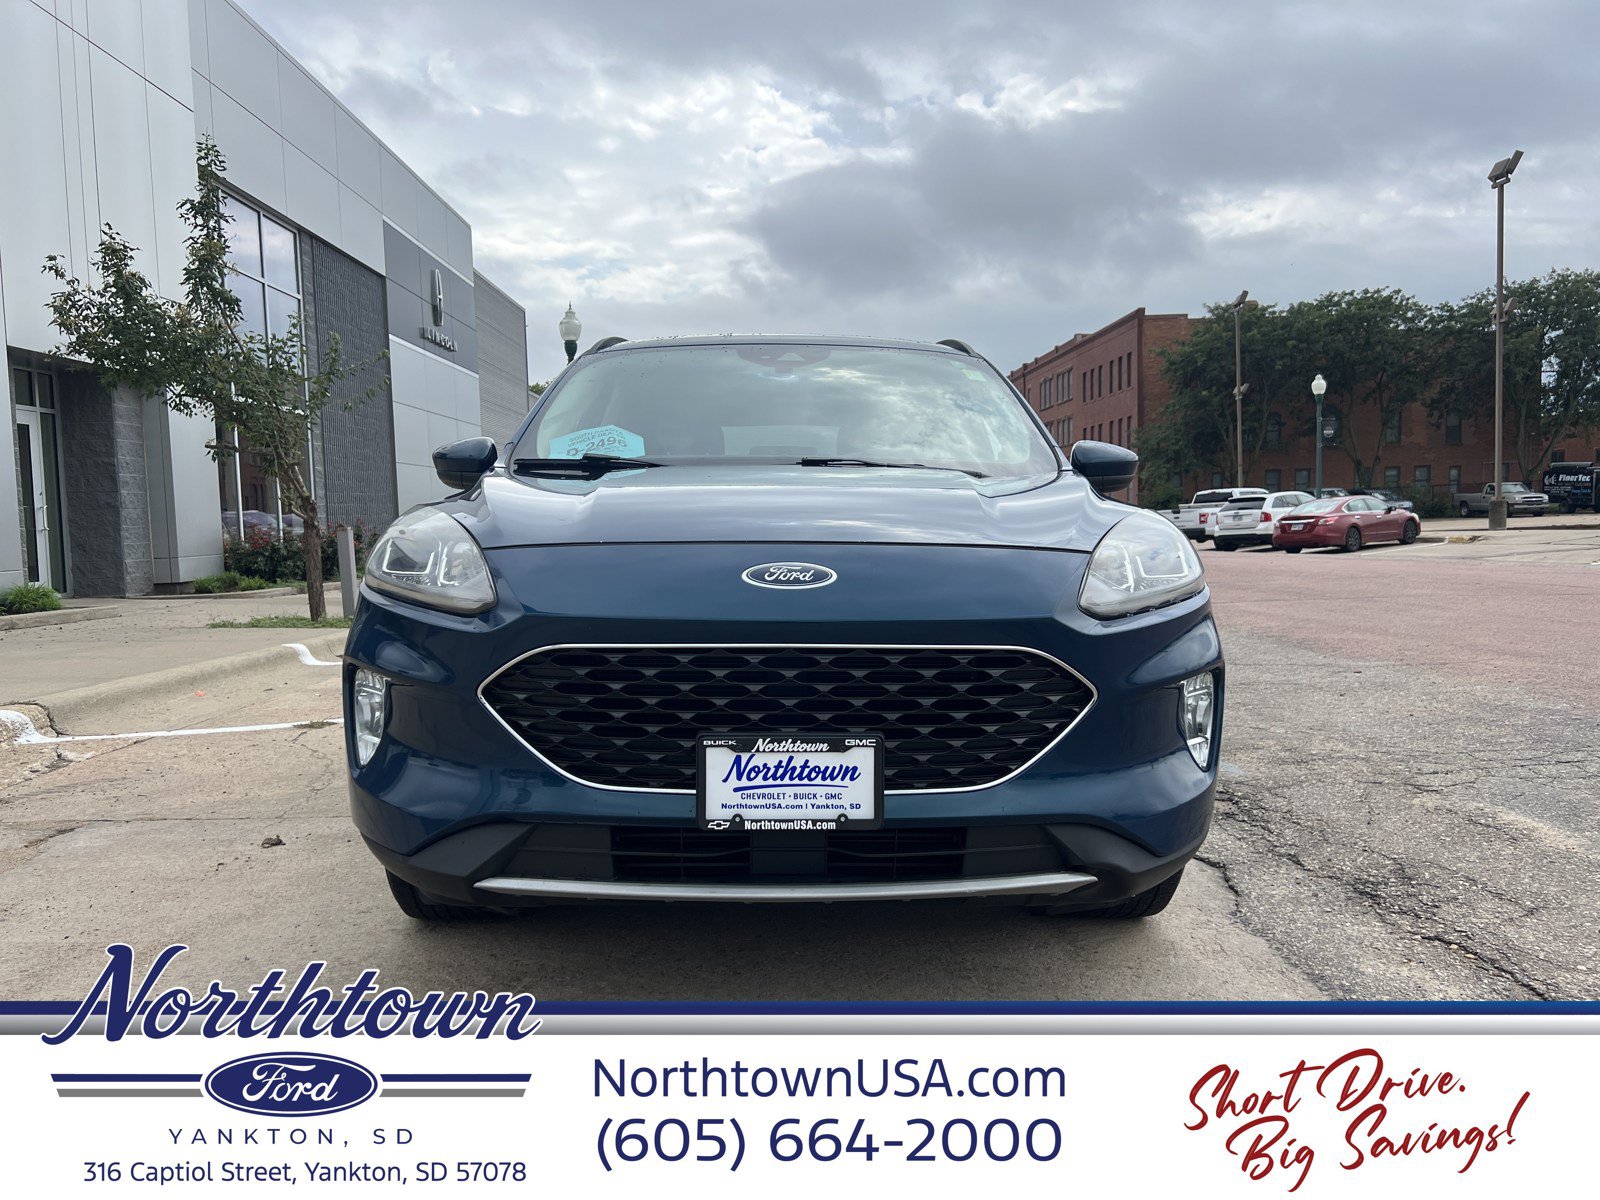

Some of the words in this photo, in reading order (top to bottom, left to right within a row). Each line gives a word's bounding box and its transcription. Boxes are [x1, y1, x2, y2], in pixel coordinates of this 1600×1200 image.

[764, 565, 815, 581] Ford
[751, 738, 830, 753] Northtown
[721, 753, 862, 783] Northtown
[740, 792, 787, 800] CHEVROLET
[793, 792, 818, 800] BUICK
[824, 792, 843, 800] GMC
[721, 802, 803, 810] NorthtownUSA.com
[810, 802, 848, 811] Yankton,
[849, 802, 862, 810] SD
[744, 820, 836, 830] NorthtownUSA.com
